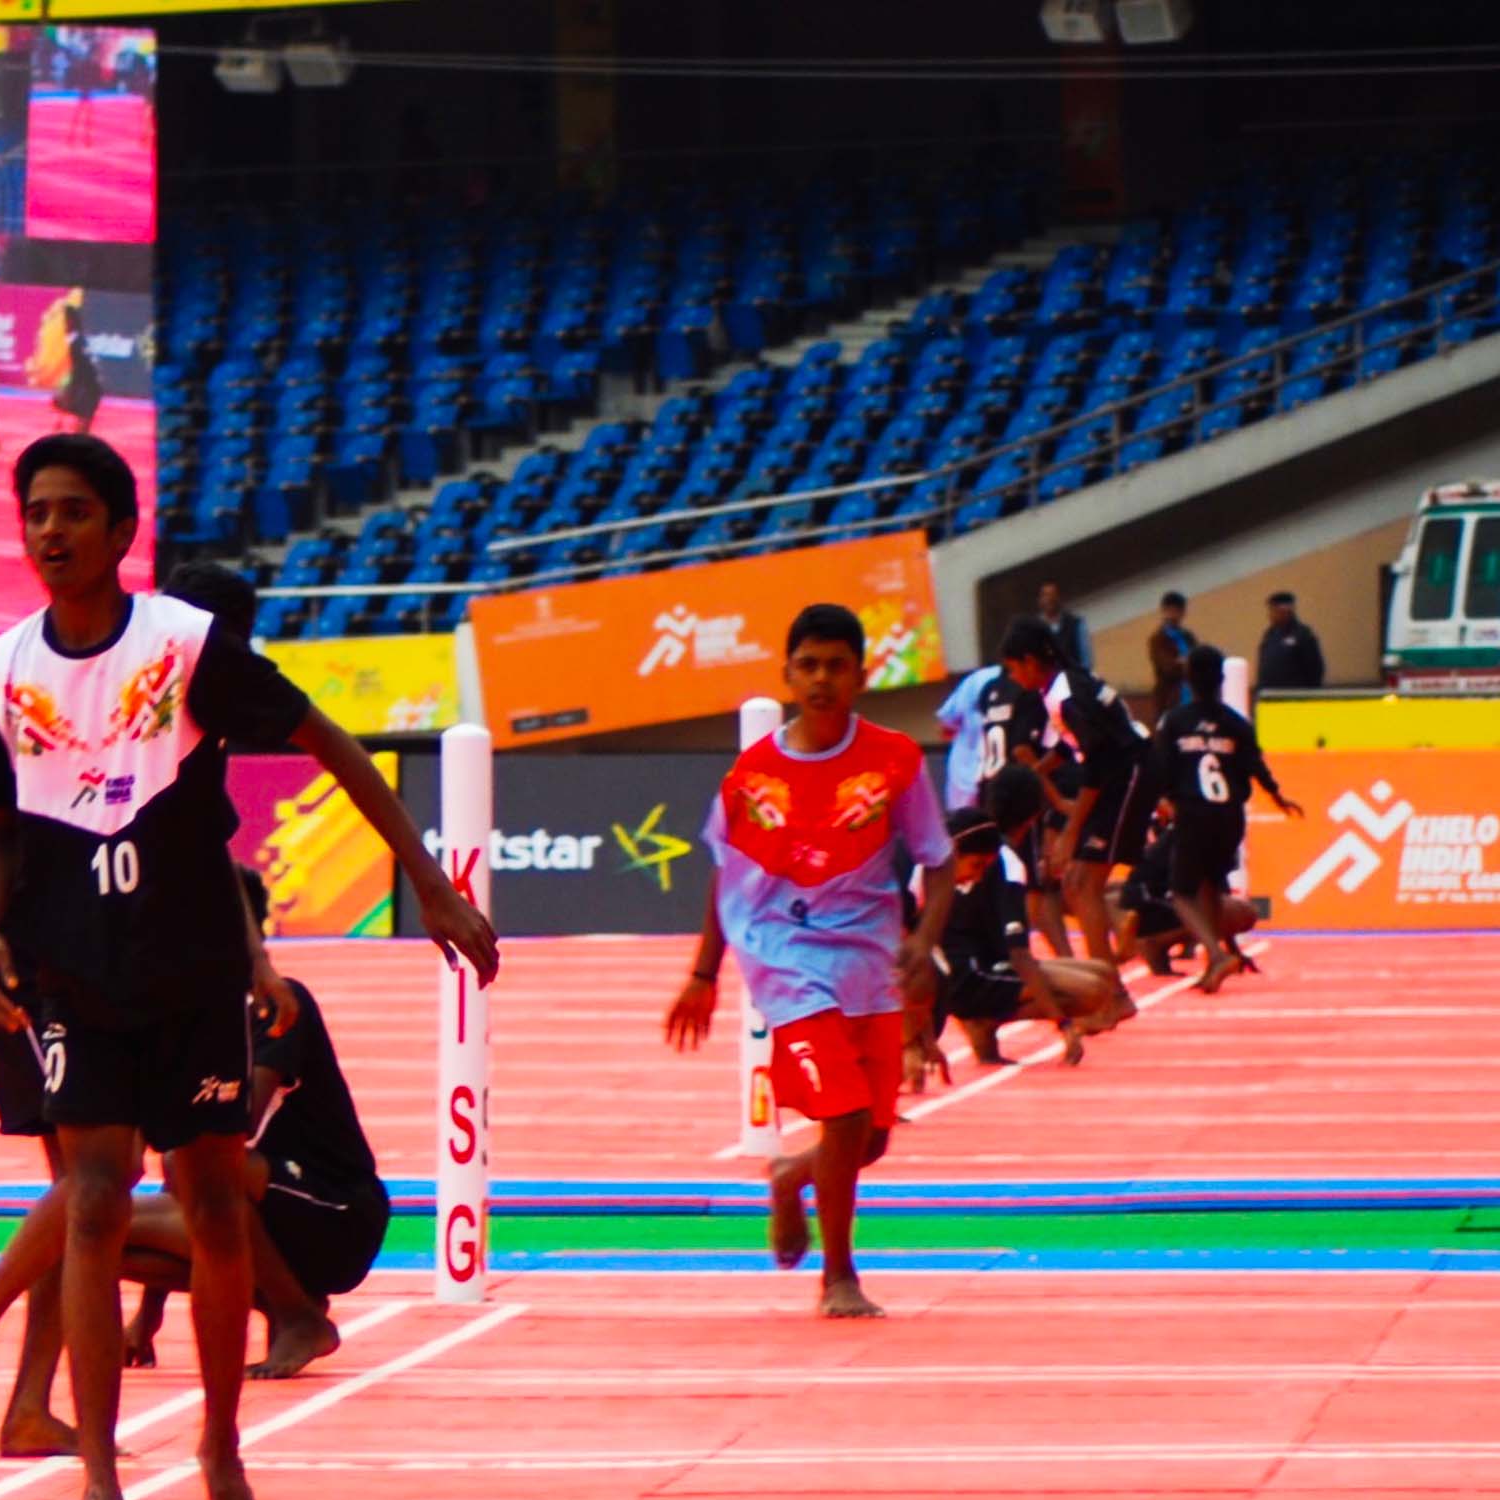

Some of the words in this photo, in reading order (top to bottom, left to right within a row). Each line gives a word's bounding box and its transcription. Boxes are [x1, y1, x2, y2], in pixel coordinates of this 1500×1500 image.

[1197, 752, 1230, 804] 6
[1403, 814, 1499, 846] KHELO
[90, 840, 140, 896] 10
[1399, 845, 1483, 874] INDIA
